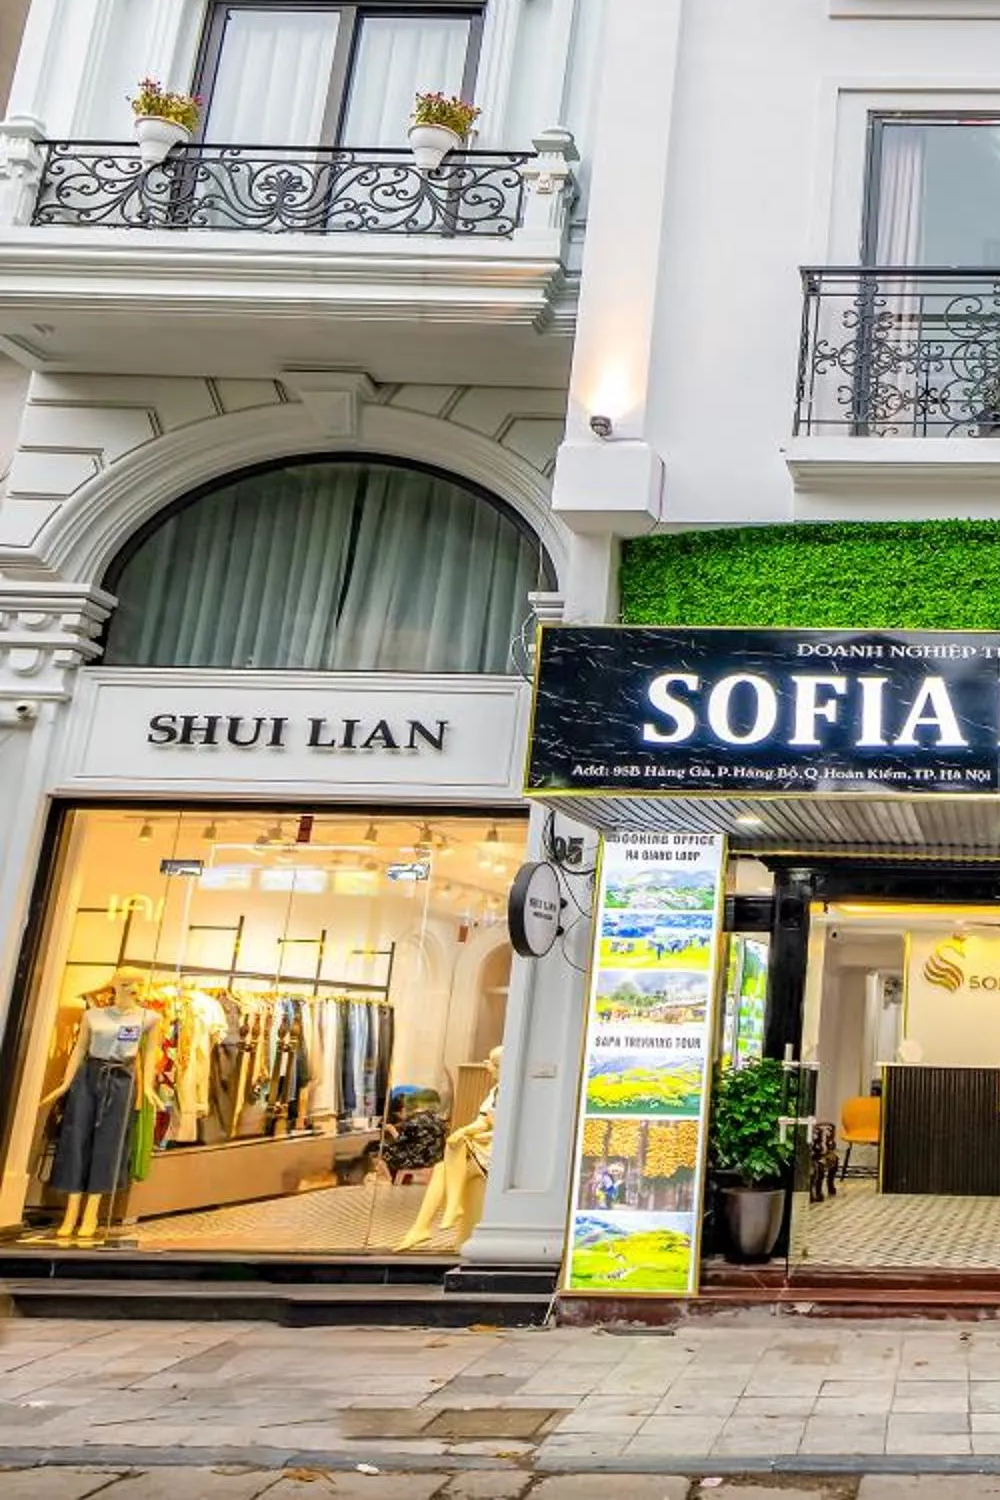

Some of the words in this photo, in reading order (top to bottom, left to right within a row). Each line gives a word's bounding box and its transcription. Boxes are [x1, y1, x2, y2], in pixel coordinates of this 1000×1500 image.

[797, 643, 883, 658] DOANH
[643, 673, 969, 747] SOFIA
[148, 713, 288, 746] SHUI
[306, 717, 448, 750] LIAN
